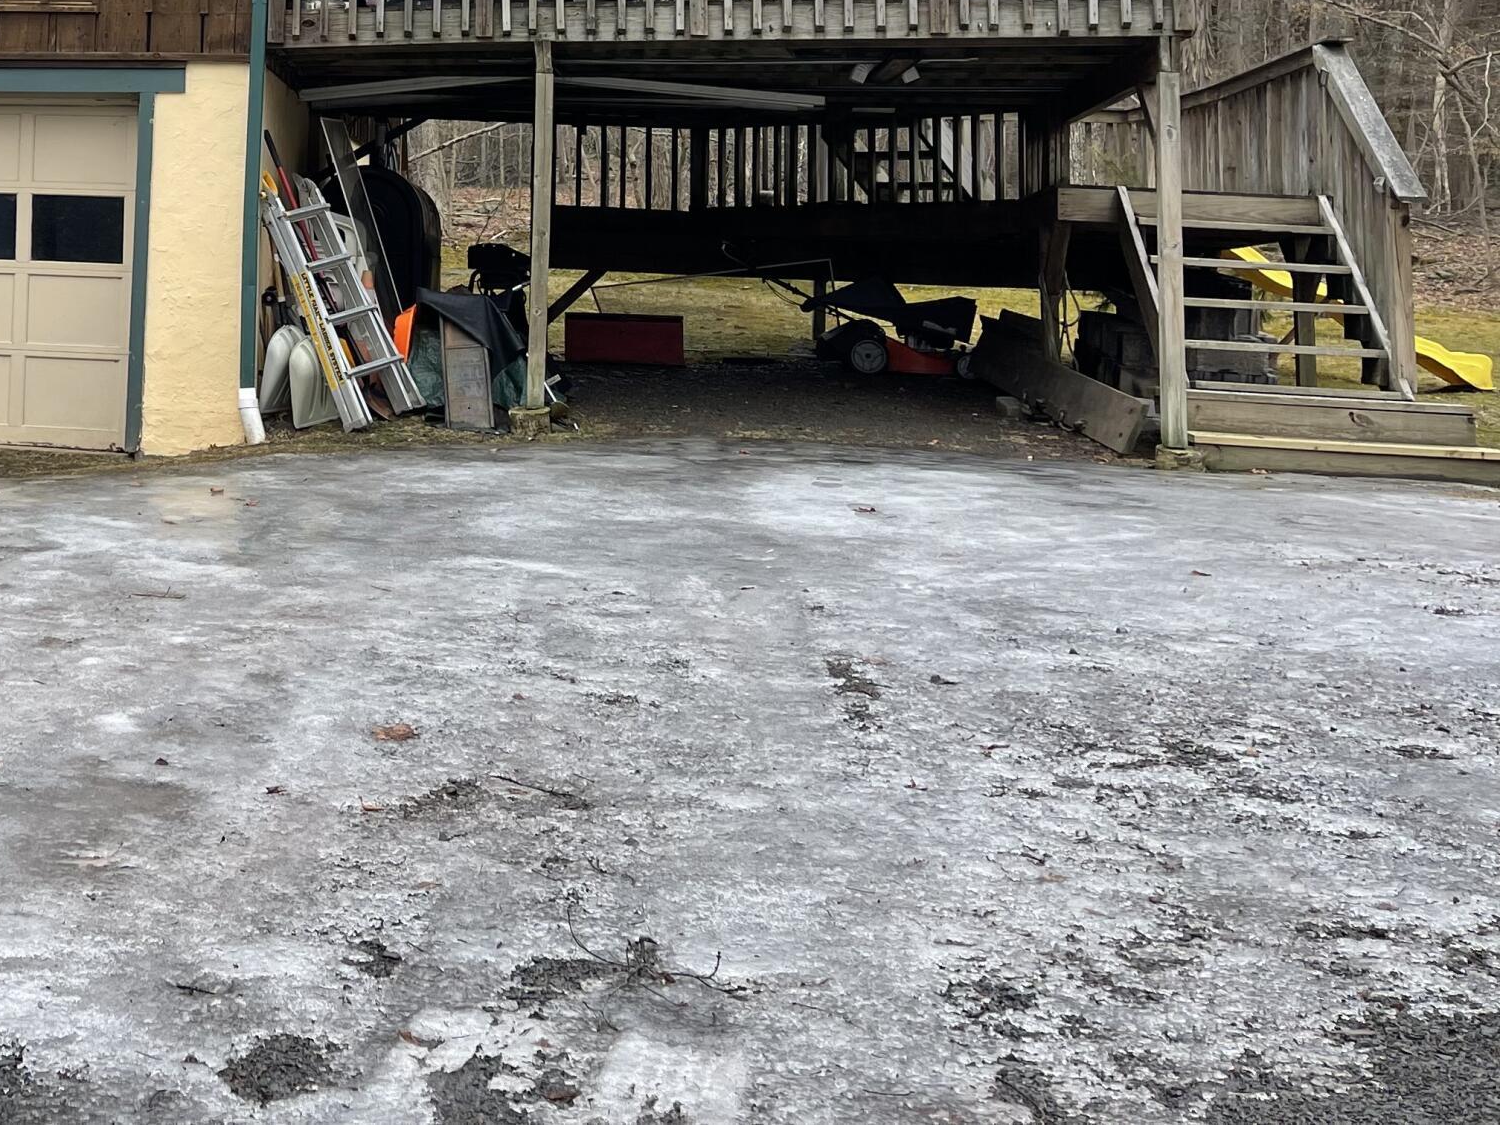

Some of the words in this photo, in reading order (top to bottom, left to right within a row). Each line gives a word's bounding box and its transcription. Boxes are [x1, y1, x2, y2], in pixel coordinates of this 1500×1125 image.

[301, 272, 314, 298] LITTLE
[319, 322, 332, 351] LADDER
[330, 352, 343, 380] SYSTEM
